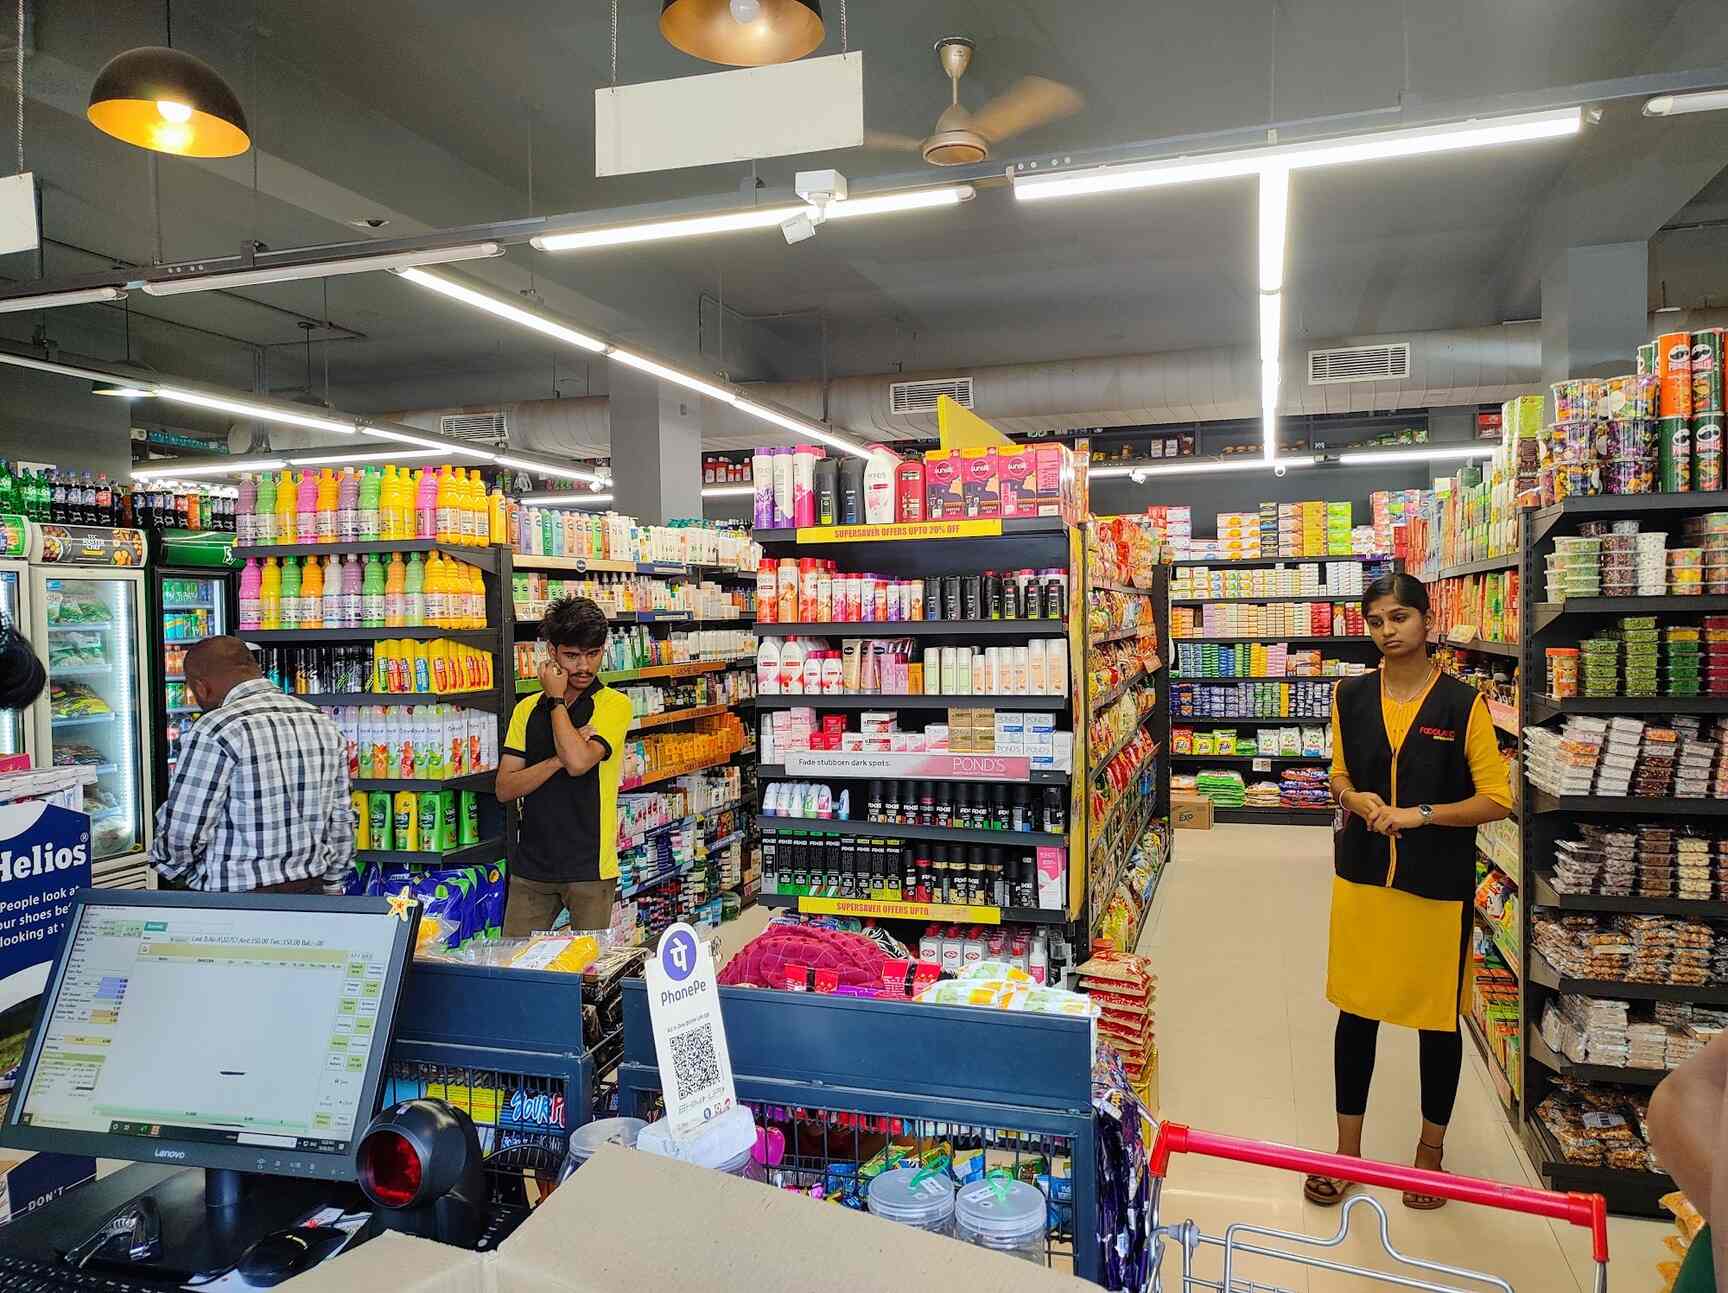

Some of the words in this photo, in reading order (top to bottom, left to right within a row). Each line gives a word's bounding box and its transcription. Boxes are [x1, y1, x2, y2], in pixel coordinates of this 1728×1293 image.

[834, 528, 880, 538] SUPERSAVER
[882, 526, 907, 537] OFFERS
[908, 526, 928, 536] UPTO
[947, 525, 960, 534] OFF
[799, 758, 816, 766] Fade
[816, 758, 850, 766] stubborn
[851, 759, 868, 767] dark
[953, 757, 1005, 772] POND'S
[0, 895, 40, 913] People
[42, 887, 67, 903] look
[836, 902, 882, 912] SUPERSAVER
[883, 904, 908, 914] OFFERS
[910, 906, 929, 916] UPTO
[20, 911, 52, 926] shoes
[0, 928, 44, 948] looking
[48, 924, 58, 934] at
[660, 980, 707, 1008] PhonePe
[154, 1149, 186, 1159] Lenovo
[28, 1186, 65, 1212] DON'T
